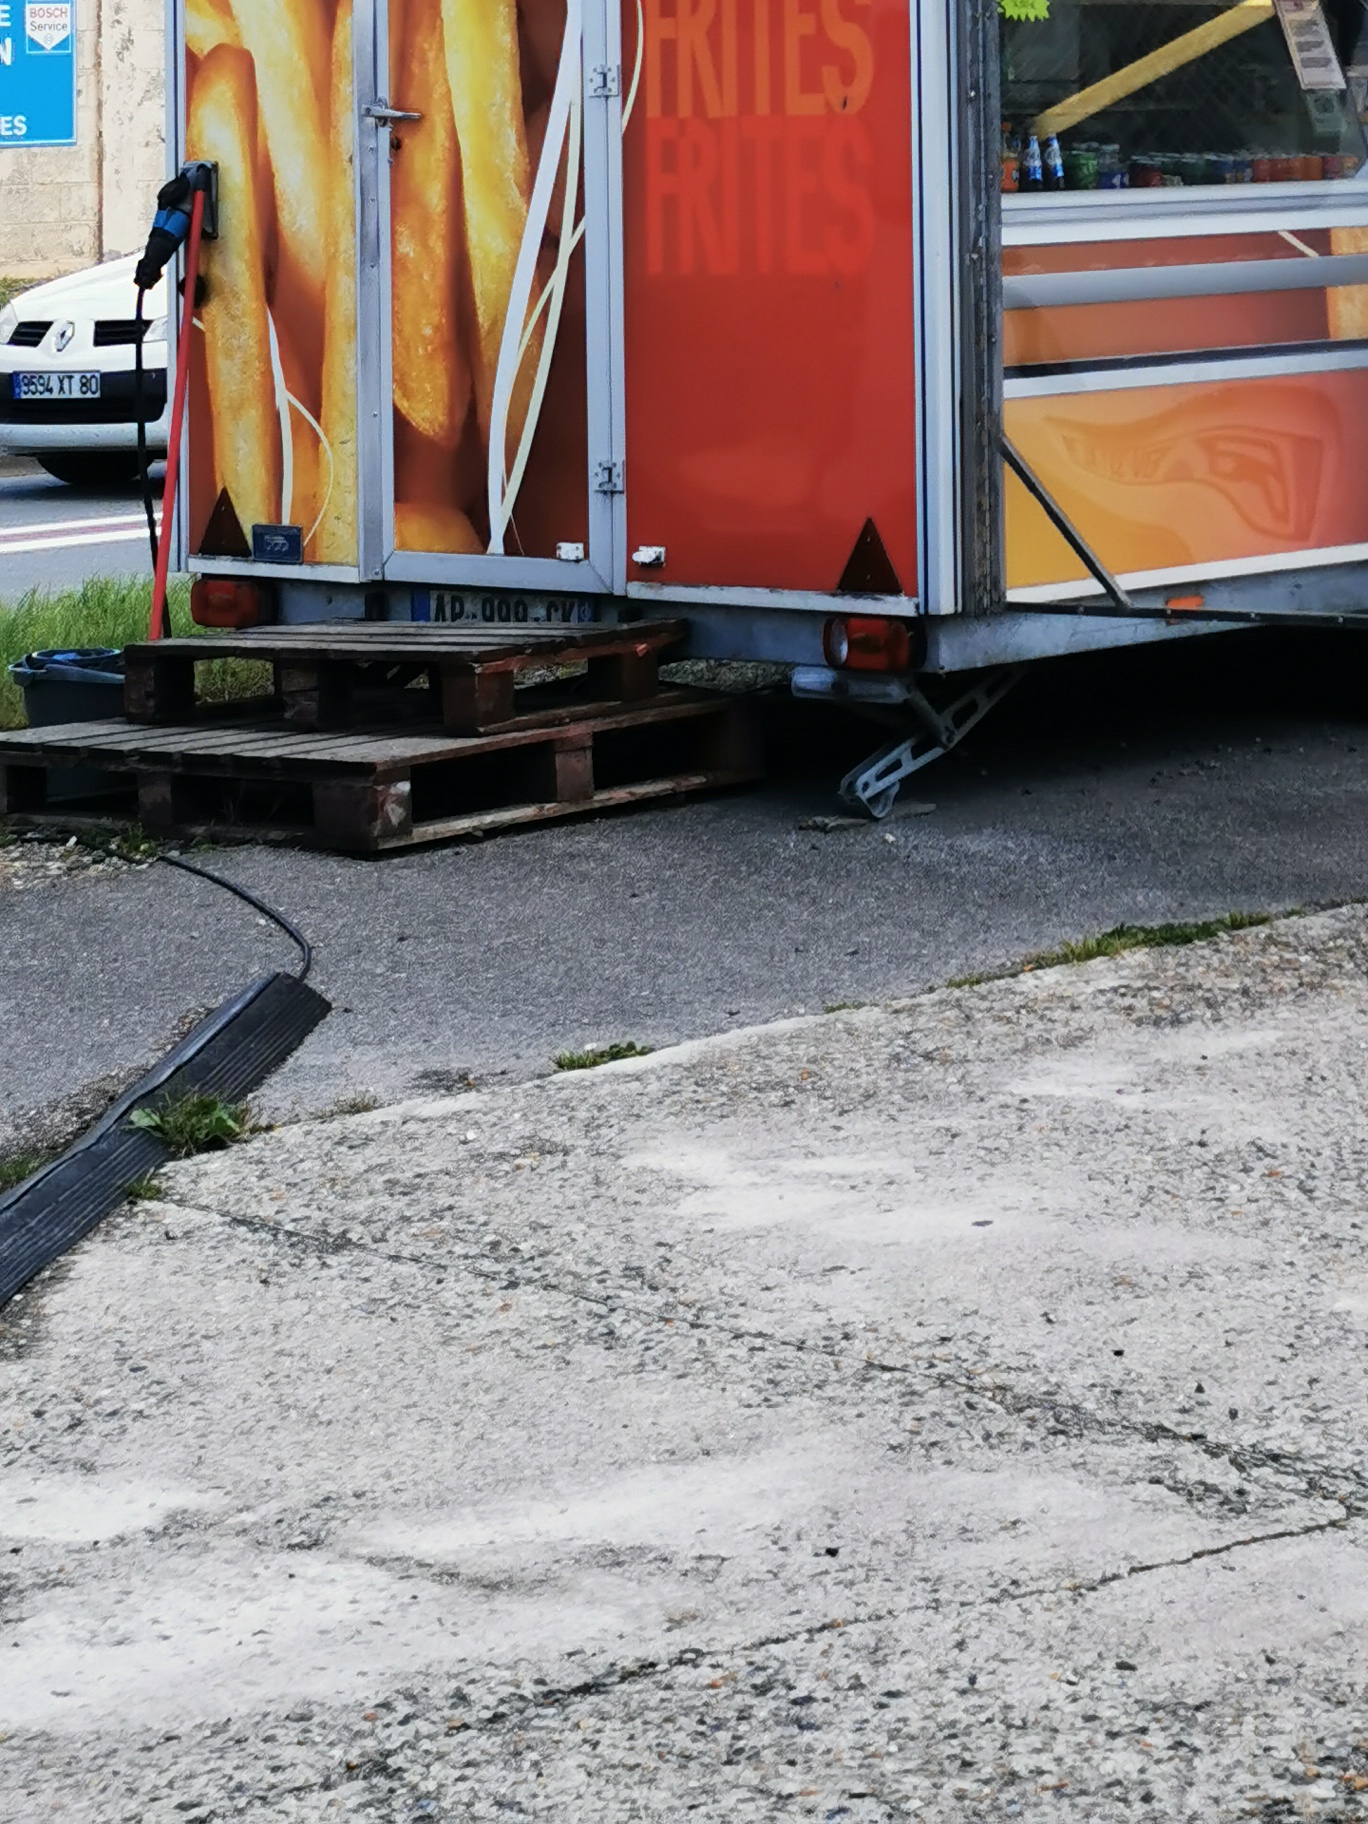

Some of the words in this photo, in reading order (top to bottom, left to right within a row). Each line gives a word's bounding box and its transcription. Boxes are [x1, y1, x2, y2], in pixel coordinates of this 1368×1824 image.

[29, 7, 68, 19] BOSCH
[30, 20, 68, 32] Service
[646, 113, 876, 276] FRITES
[21, 374, 53, 396] 9594
[57, 374, 74, 396] XT
[79, 374, 99, 396] 80
